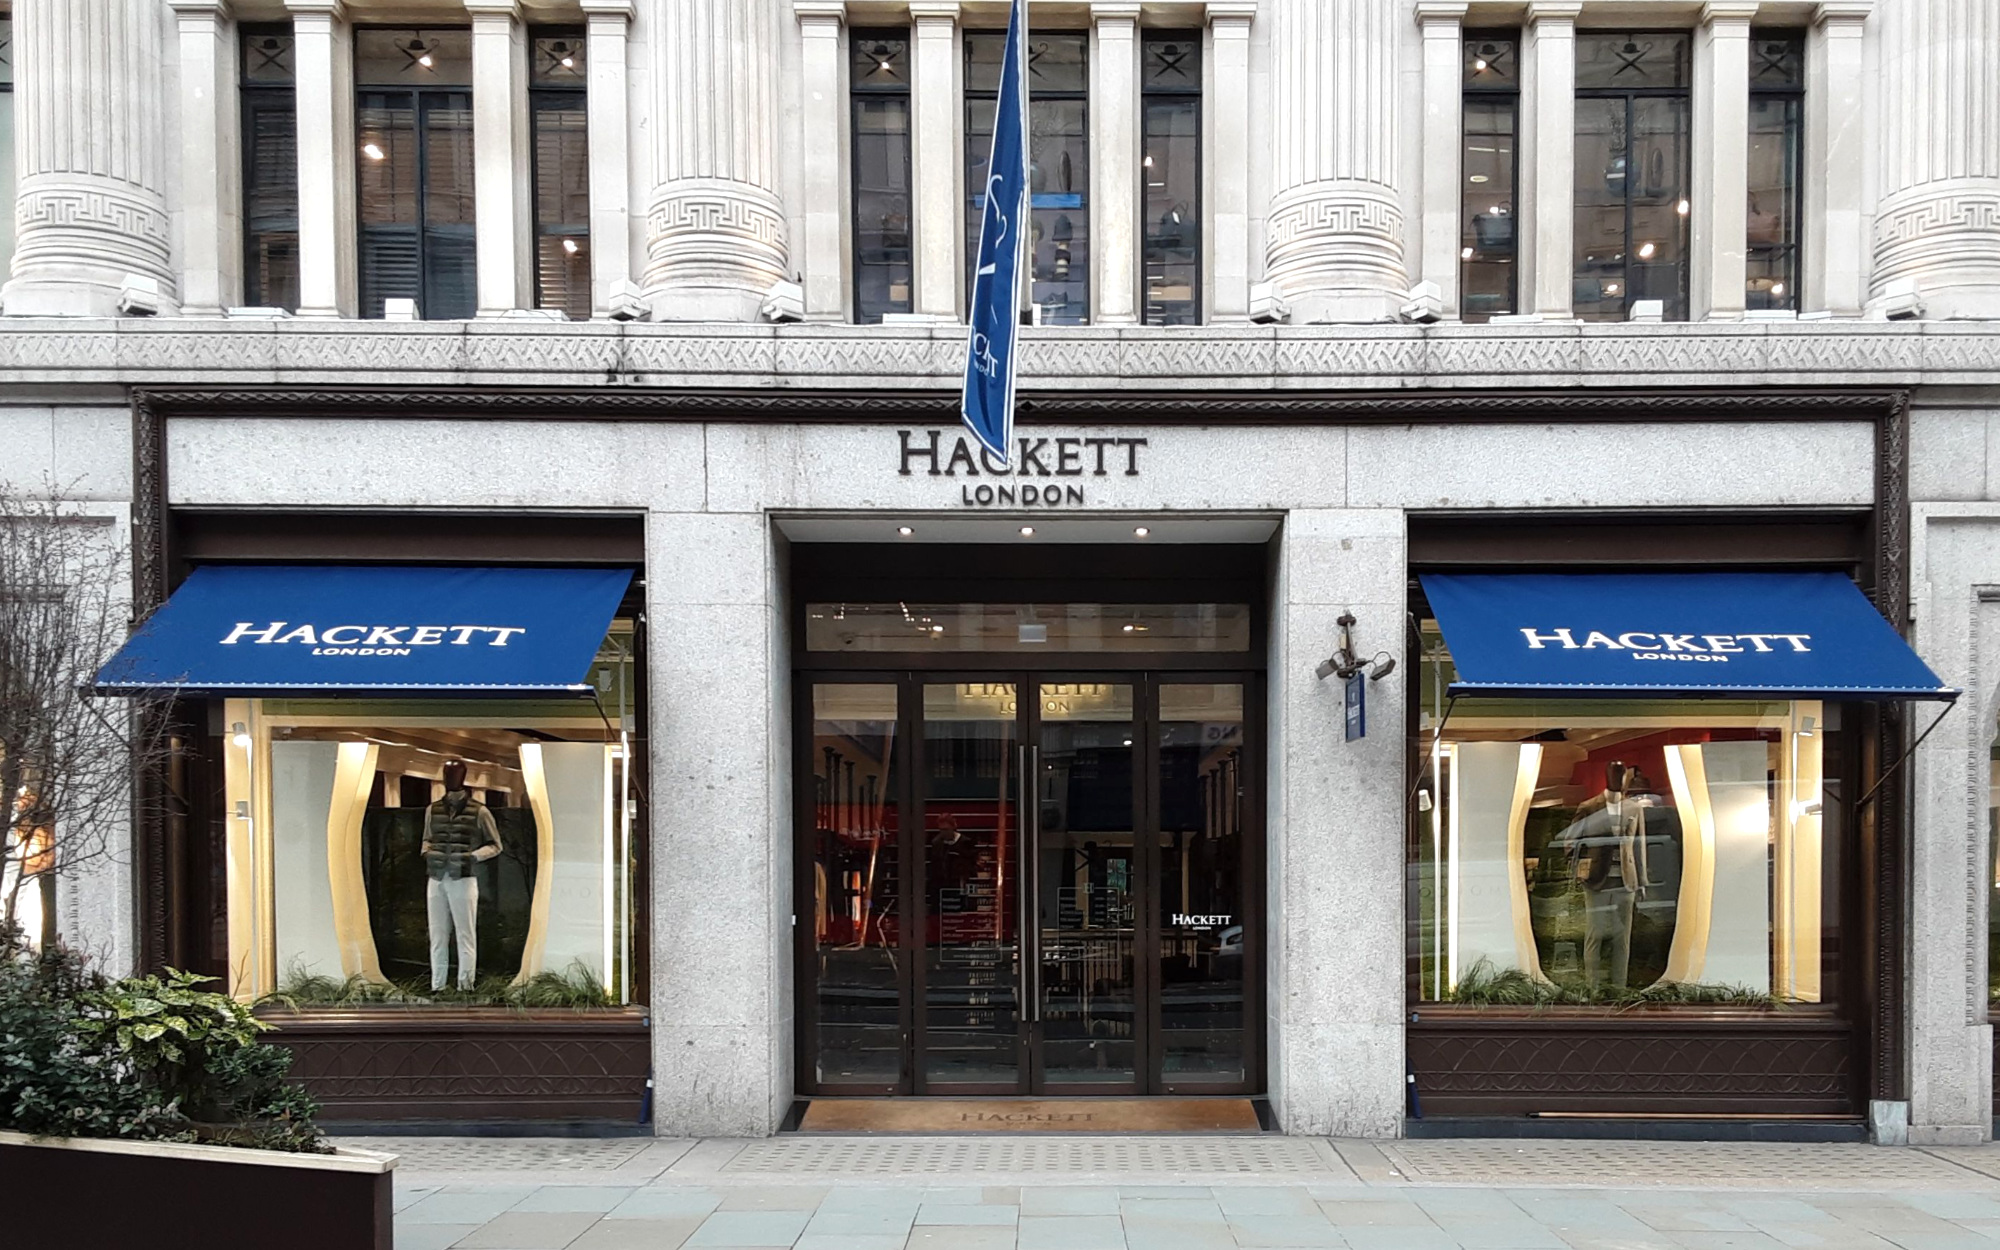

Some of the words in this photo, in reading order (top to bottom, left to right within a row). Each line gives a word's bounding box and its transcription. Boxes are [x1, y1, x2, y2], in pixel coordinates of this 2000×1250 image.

[897, 430, 1148, 476] HACKETT
[962, 484, 1084, 505] LONDON
[219, 621, 526, 646] HACKETT
[1519, 628, 1811, 652] HACKETT
[312, 647, 411, 656] LONDON
[1632, 652, 1729, 662] LONDON
[1171, 913, 1231, 925] HACKETT
[961, 1112, 1097, 1122] HACKETT
